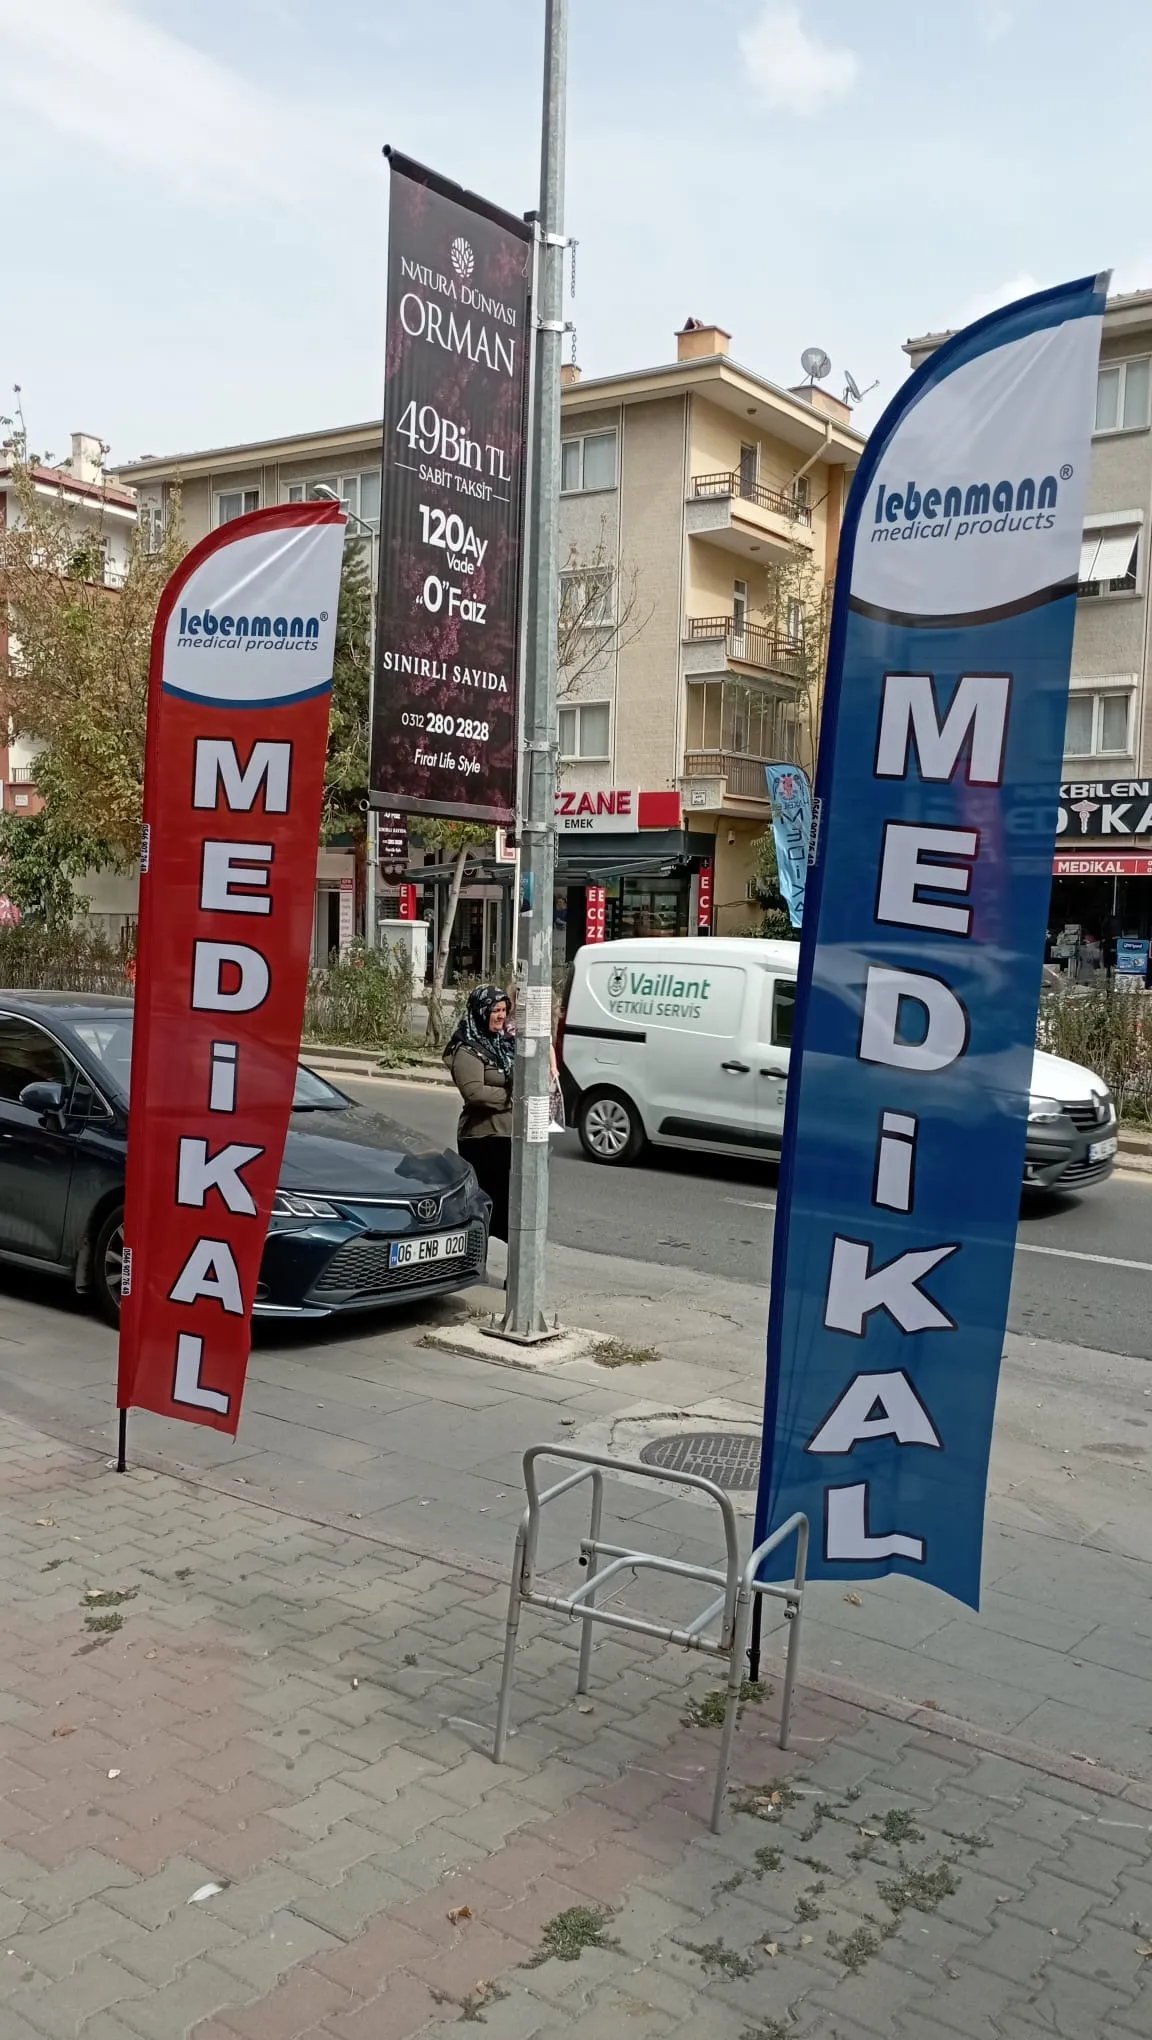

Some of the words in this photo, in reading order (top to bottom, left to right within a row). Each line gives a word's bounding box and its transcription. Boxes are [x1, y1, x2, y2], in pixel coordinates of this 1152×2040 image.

[401, 256, 457, 300] NATURA
[461, 285, 516, 327] DÜNYASI
[400, 293, 516, 377] ORMAN
[485, 444, 511, 481] TL
[418, 464, 452, 488] SABİT
[454, 475, 493, 501] TAKSİT
[871, 518, 952, 542] medical
[955, 512, 1055, 540] products
[446, 551, 474, 575] Vade
[177, 637, 241, 649] medical
[246, 637, 318, 651] products
[383, 651, 447, 680] SINIRLI
[453, 665, 508, 692] SAYIDA
[426, 712, 454, 735] 280
[456, 717, 489, 741] 2828
[439, 751, 456, 770] Life
[458, 755, 481, 776] Style
[564, 818, 594, 829] EMEK
[631, 972, 711, 999] Vaillant
[609, 999, 655, 1016] YETKİLİ
[656, 1002, 702, 1019] SERVİS
[398, 1243, 412, 1263] 06
[418, 1240, 439, 1260] ENB
[445, 1235, 464, 1255] 020
